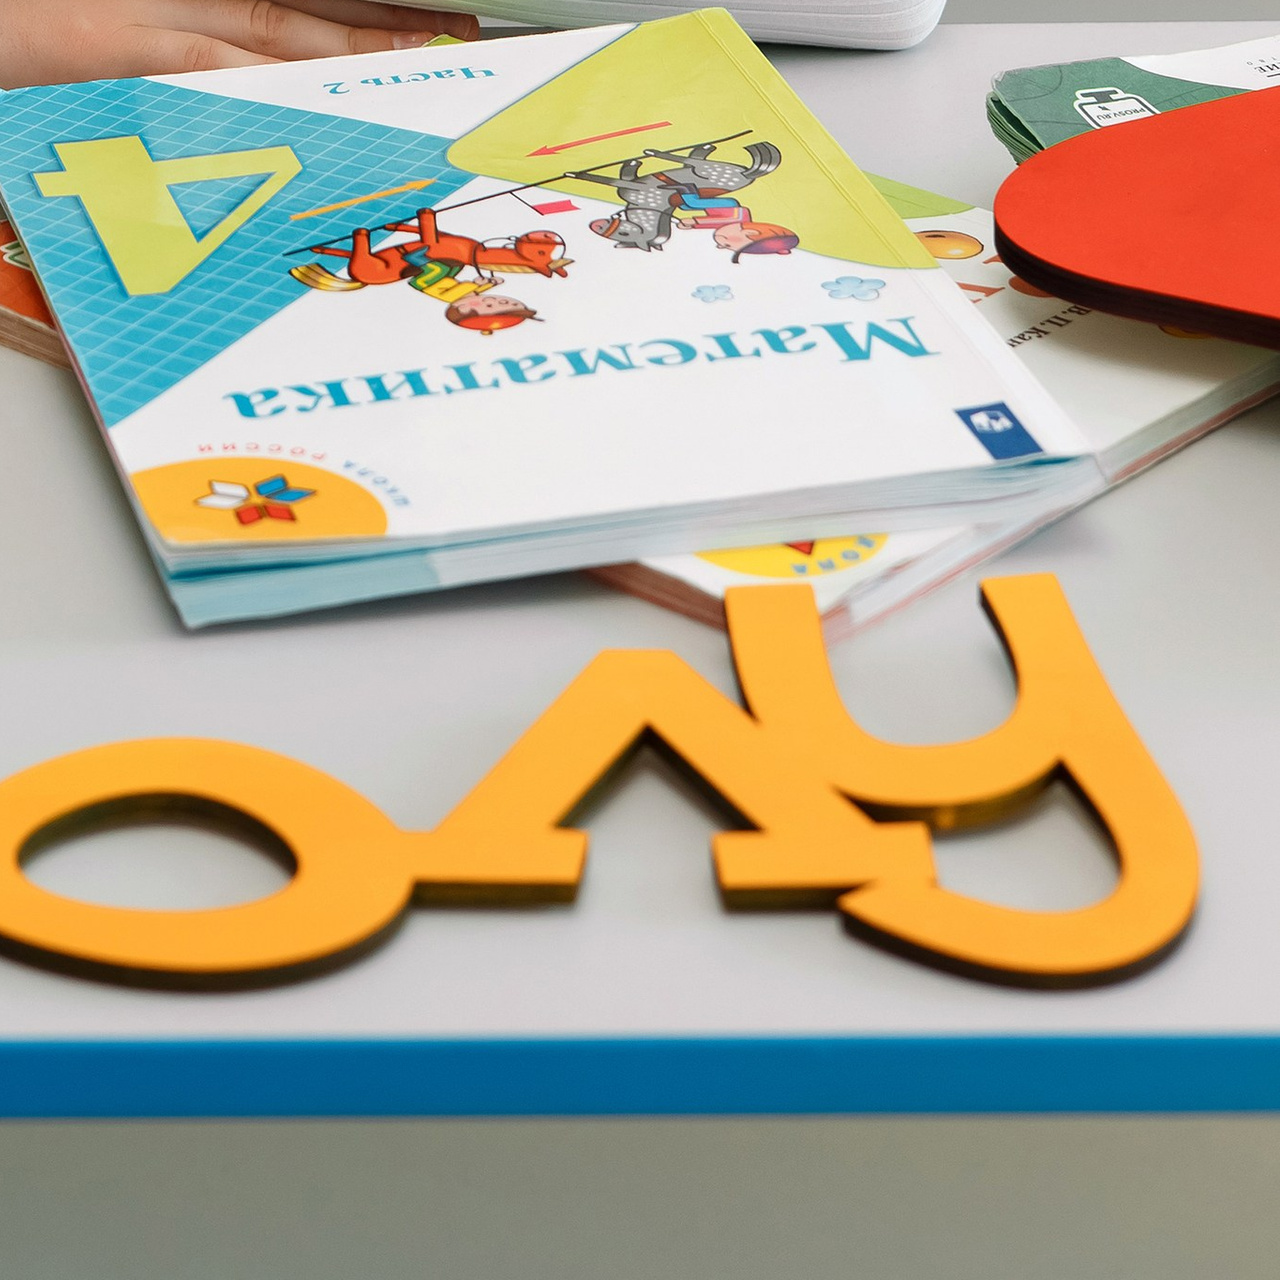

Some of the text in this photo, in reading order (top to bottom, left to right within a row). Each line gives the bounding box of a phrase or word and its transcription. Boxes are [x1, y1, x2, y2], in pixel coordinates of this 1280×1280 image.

[323, 66, 499, 95] Часть 2
[1096, 107, 1146, 121] PROSV.RU
[34, 134, 303, 296] 4
[225, 316, 940, 419] Математика
[196, 442, 410, 507] ШКОЛА РОССИИ
